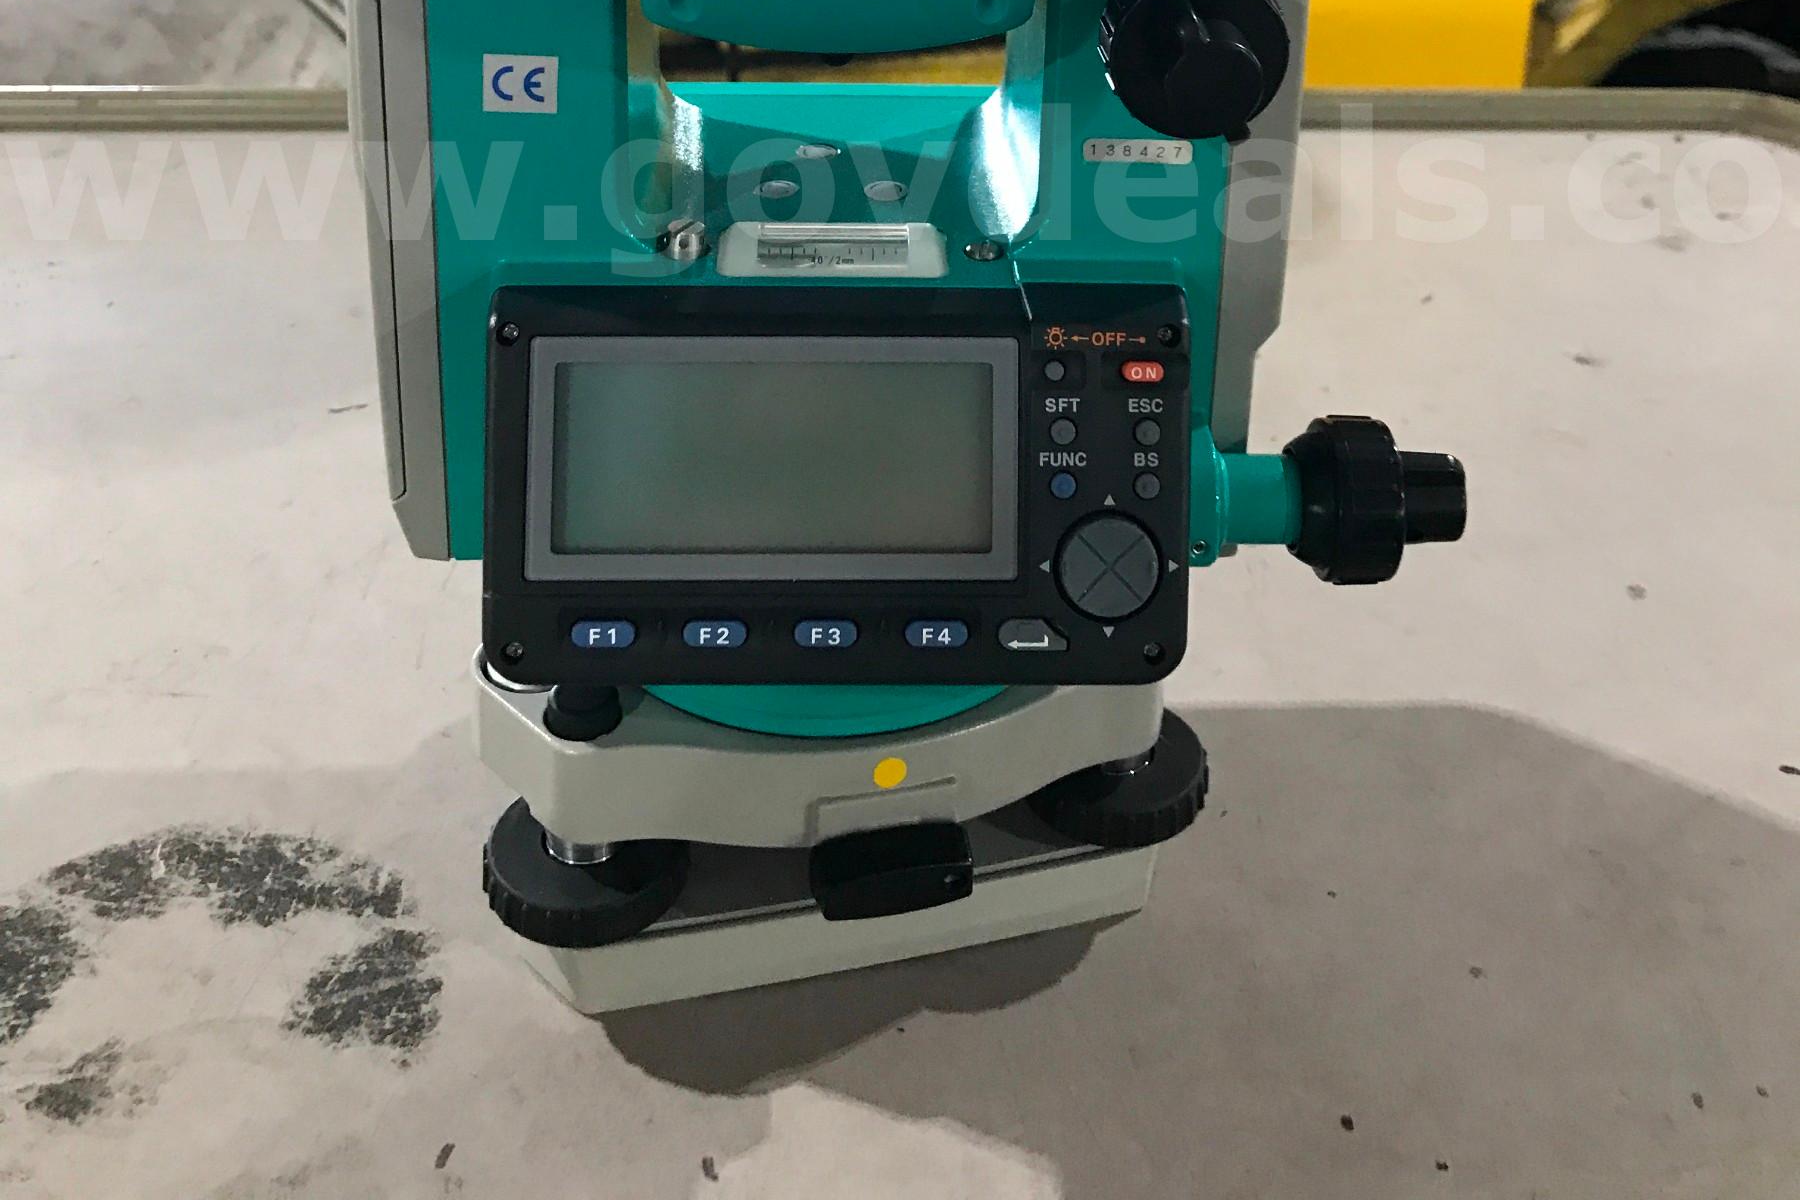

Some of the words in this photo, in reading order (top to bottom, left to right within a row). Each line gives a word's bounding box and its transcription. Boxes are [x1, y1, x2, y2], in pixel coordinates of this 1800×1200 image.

[492, 65, 545, 103] CE
[1090, 144, 1182, 158] 138427
[1092, 332, 1126, 346] OFF
[1131, 367, 1157, 379] ON
[1045, 398, 1080, 413] SFT
[1128, 398, 1164, 413] ESC
[1039, 452, 1087, 467] FUNC
[1133, 452, 1159, 467] BS
[589, 628, 616, 645] F1
[700, 627, 730, 645] F2
[811, 627, 841, 645] F3
[922, 627, 952, 645] F4
